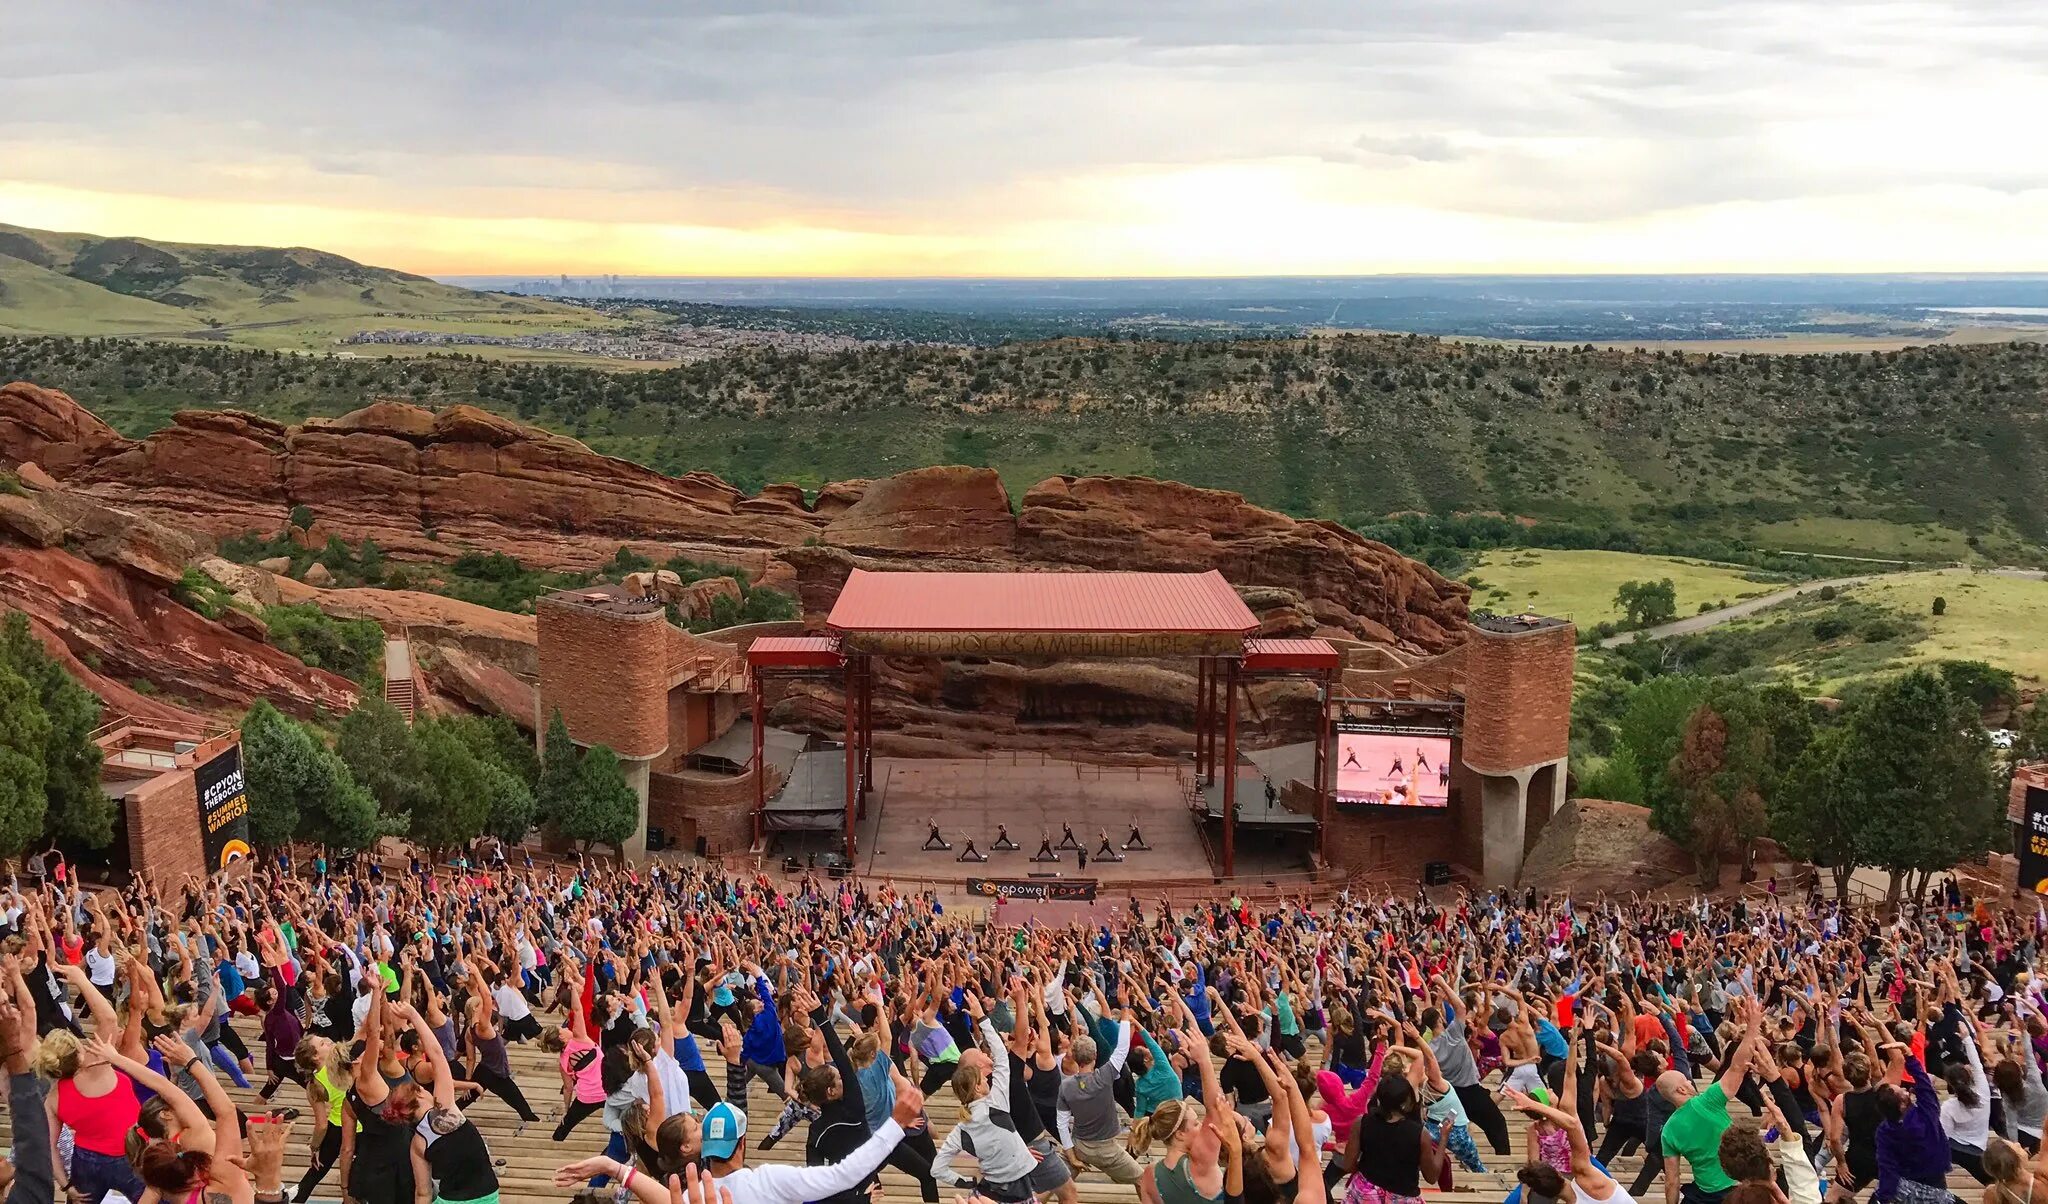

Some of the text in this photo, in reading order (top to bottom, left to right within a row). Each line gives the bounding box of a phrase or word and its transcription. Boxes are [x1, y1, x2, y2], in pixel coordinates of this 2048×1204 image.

[904, 635, 1183, 655] RED ROCKS AMPHITHEATRE
[204, 770, 242, 801] #CPYON
[205, 780, 243, 810] THEROCKS
[207, 794, 247, 824] #SUMMER
[208, 804, 248, 833] WARRIOR
[2031, 835, 2048, 847] #S
[1050, 888, 1086, 896] YOGA
